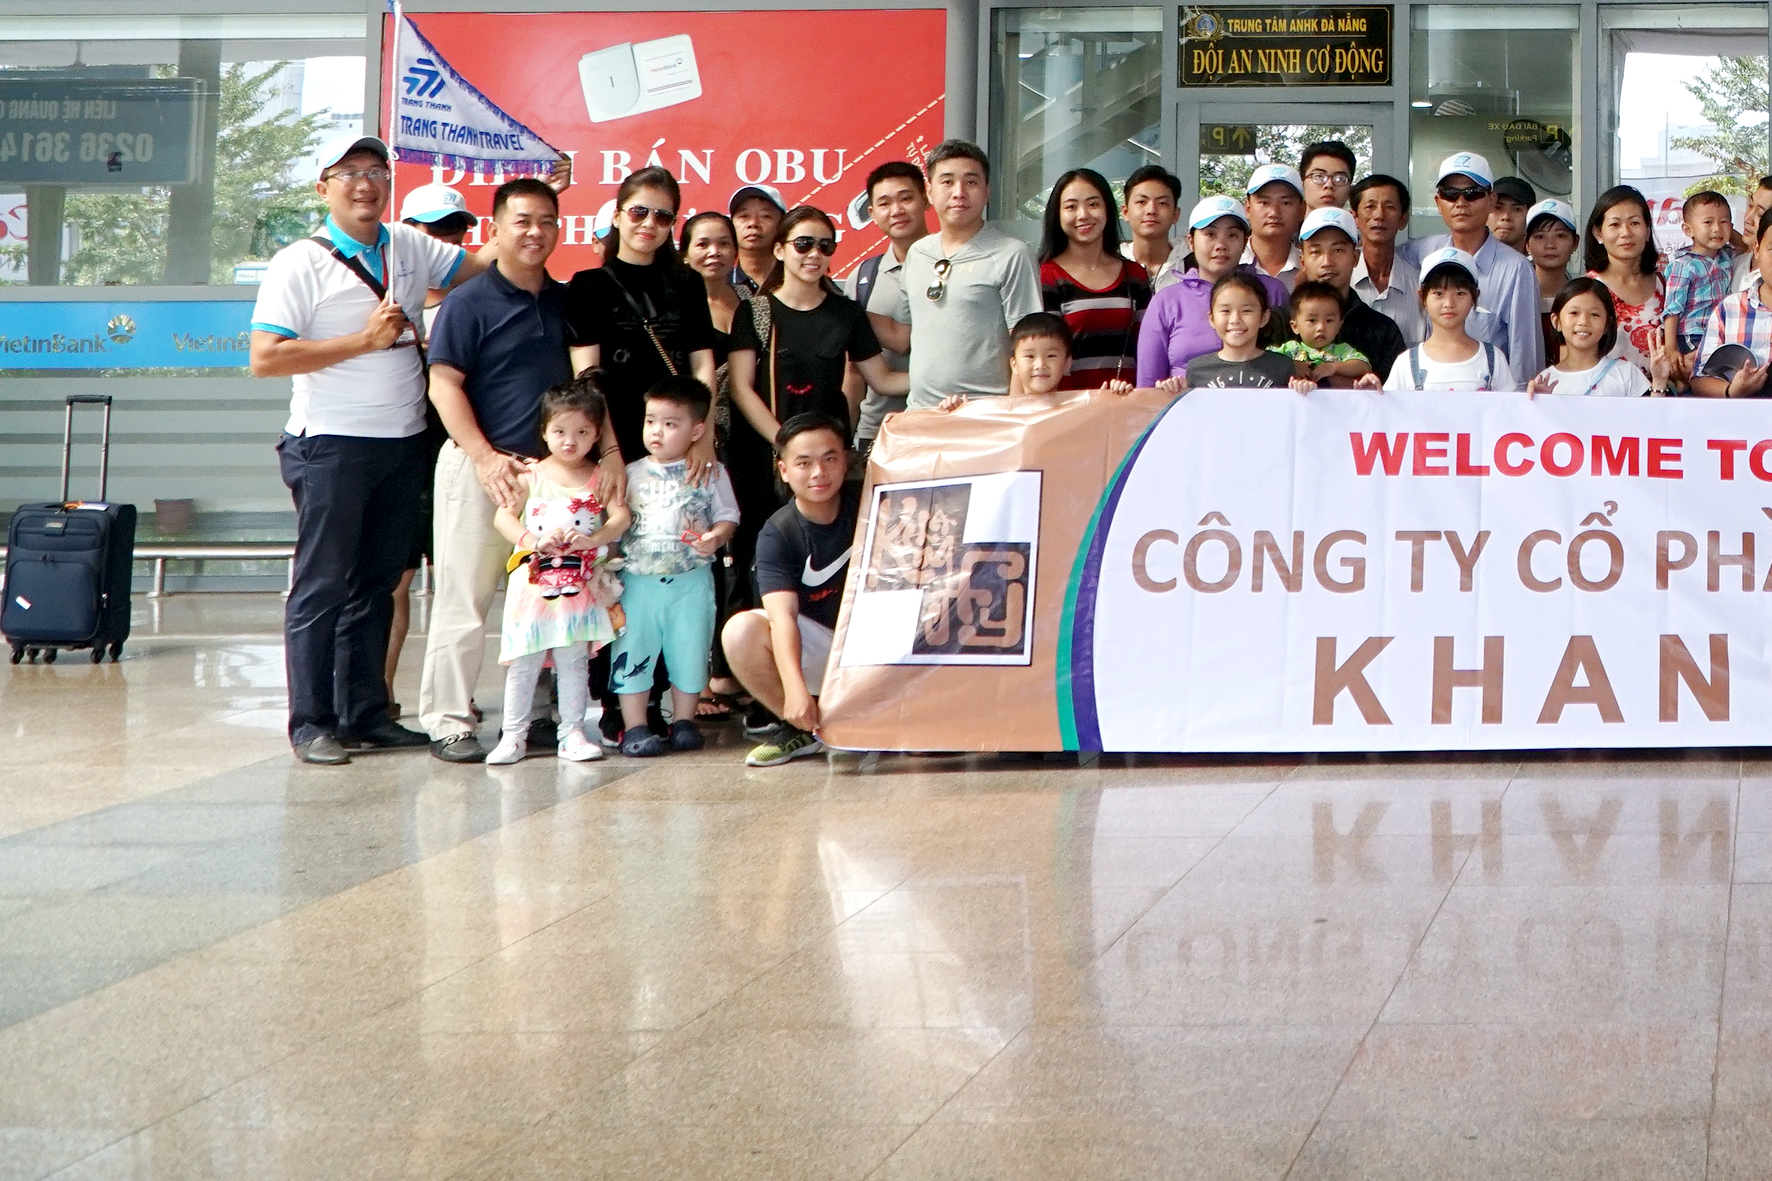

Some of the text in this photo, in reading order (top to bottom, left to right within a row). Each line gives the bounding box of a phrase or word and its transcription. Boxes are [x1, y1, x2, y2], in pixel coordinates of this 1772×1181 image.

[1227, 12, 1367, 33] TRUNG TÂM ANHK ĐÀ NẴNG
[1193, 42, 1384, 81] ĐỘI AN NINH CƠ ĐỘNG
[401, 97, 452, 112] TRANG THANH
[400, 115, 524, 151] TRANG THANH TRAVEL
[599, 138, 715, 185] BÁN
[736, 148, 848, 185] OBU
[172, 332, 251, 353] VietinB
[1350, 432, 1683, 480] WELCOME
[1131, 511, 1367, 594] CÔNG
[1394, 530, 1491, 593] TY
[1517, 499, 1625, 594] CỔ
